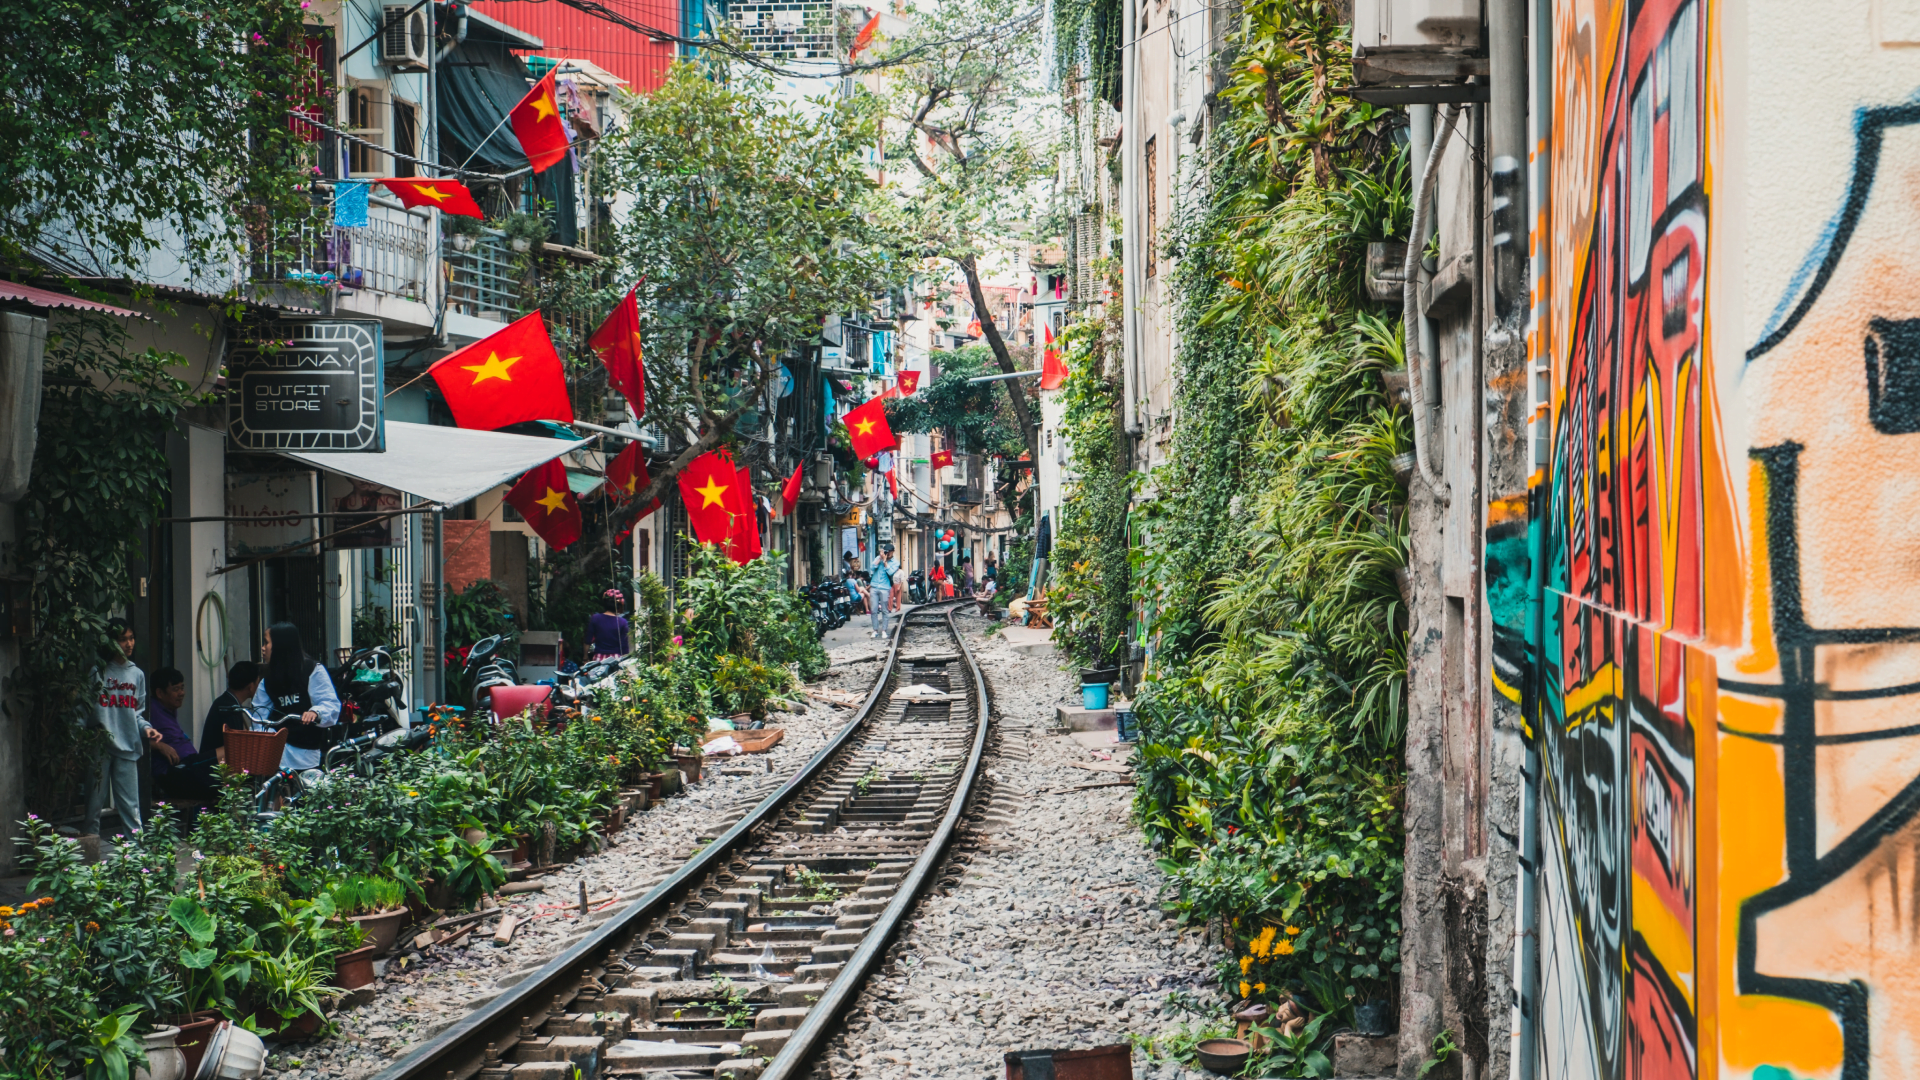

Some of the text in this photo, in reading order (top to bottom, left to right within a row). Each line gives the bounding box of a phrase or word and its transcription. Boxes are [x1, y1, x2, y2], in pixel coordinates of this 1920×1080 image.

[229, 353, 357, 368] RAILWAY
[255, 385, 331, 396] OUTFIT
[255, 400, 321, 411] STORE
[848, 512, 858, 520] 17
